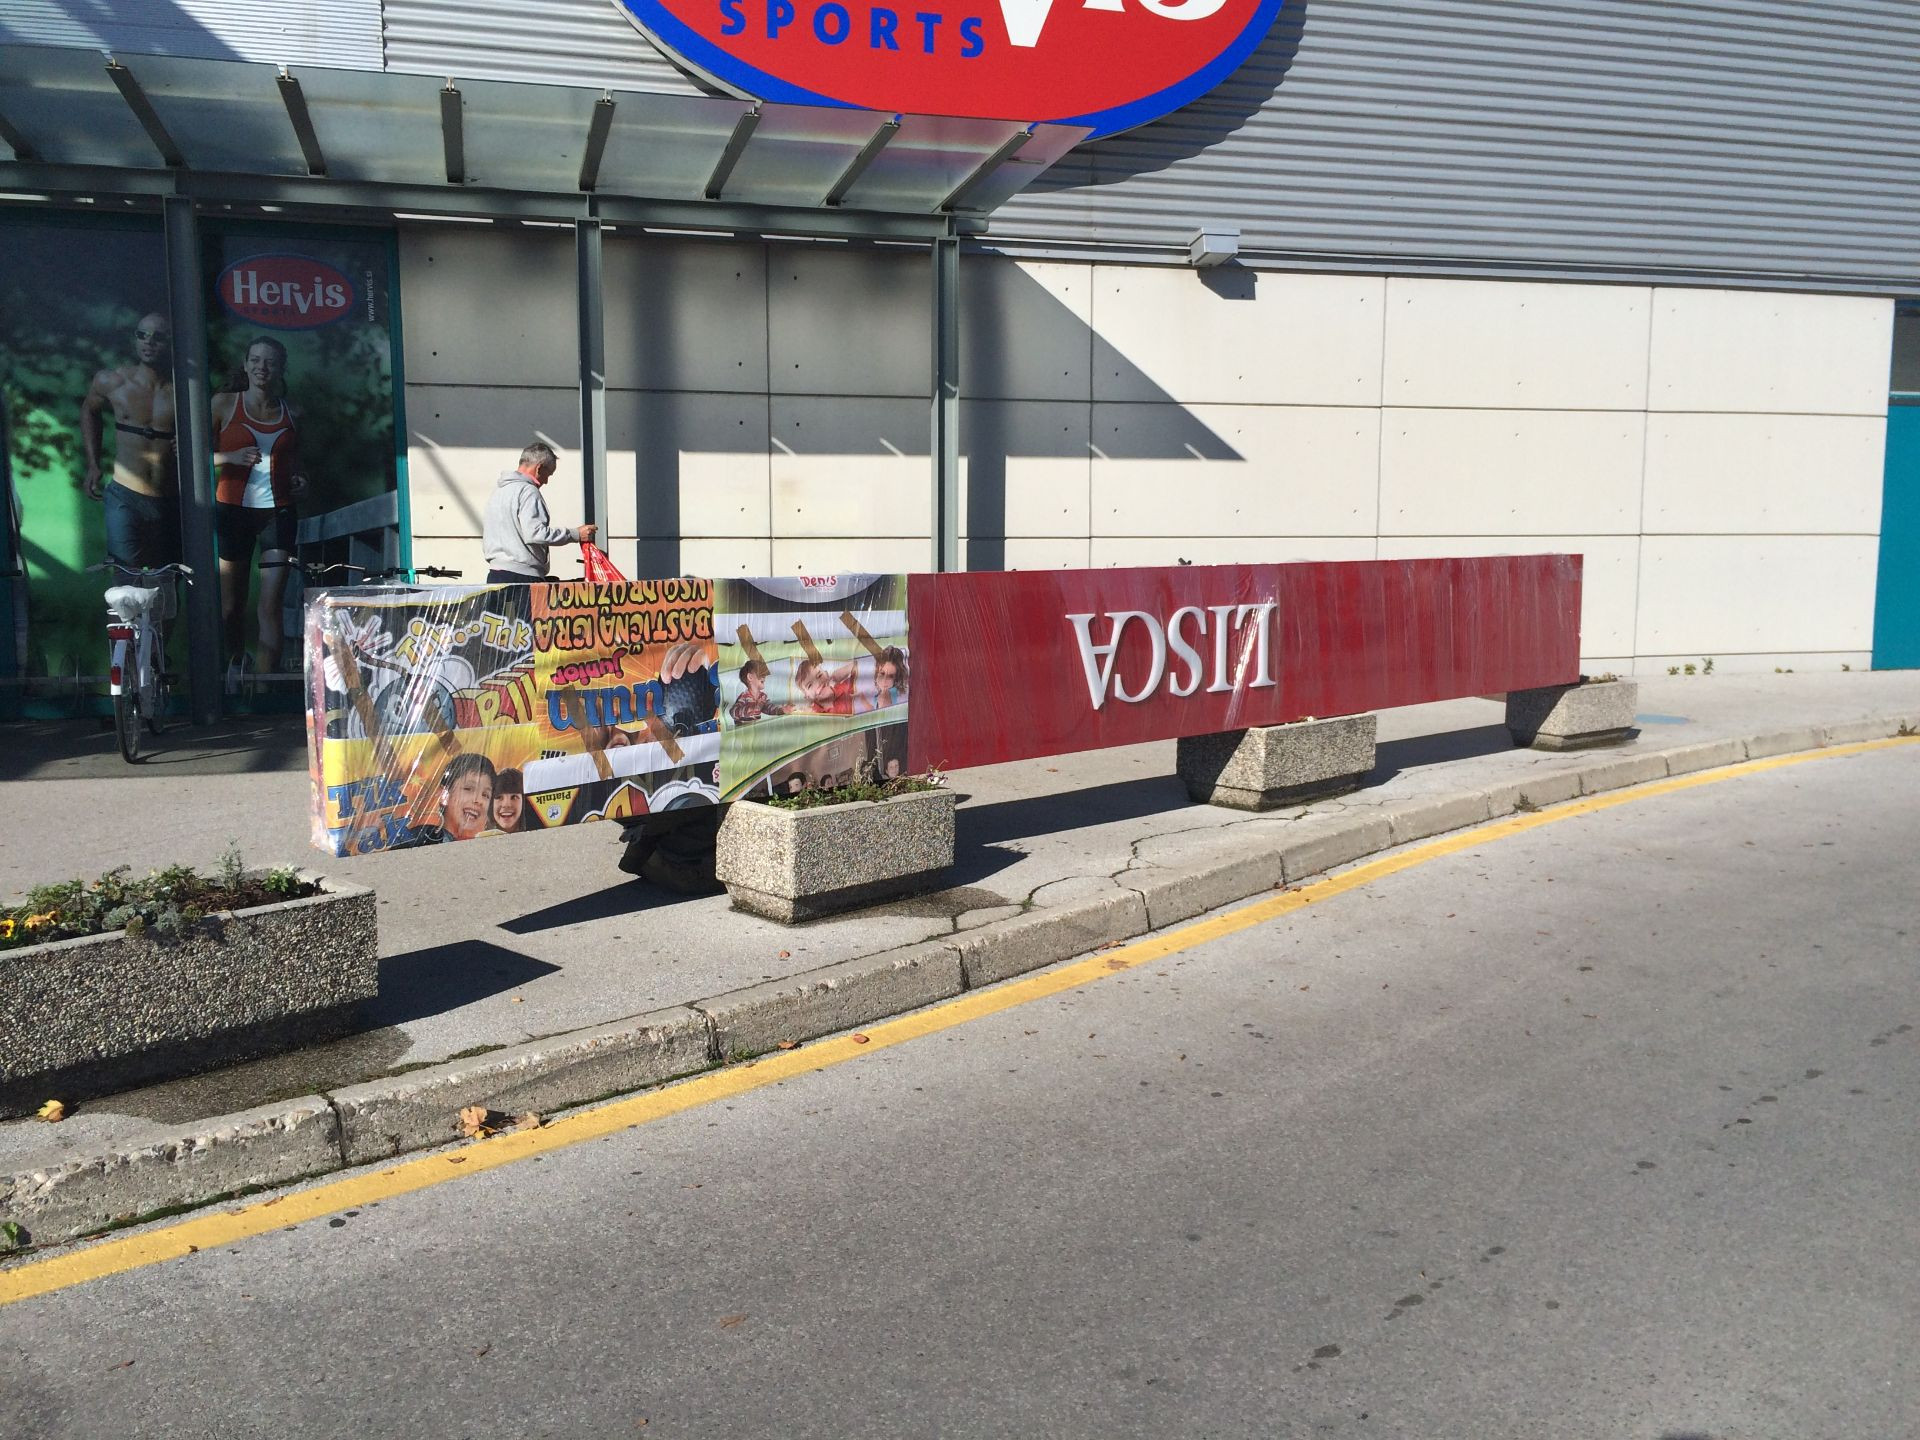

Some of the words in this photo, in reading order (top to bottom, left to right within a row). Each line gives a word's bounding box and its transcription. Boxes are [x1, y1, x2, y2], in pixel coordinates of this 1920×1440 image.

[719, 0, 985, 58] SPORTS
[232, 270, 346, 314] Hervis
[533, 613, 596, 653] IGRA
[550, 647, 629, 686] junior
[1065, 603, 1278, 710] LISCA
[535, 790, 573, 805] Piatnik
